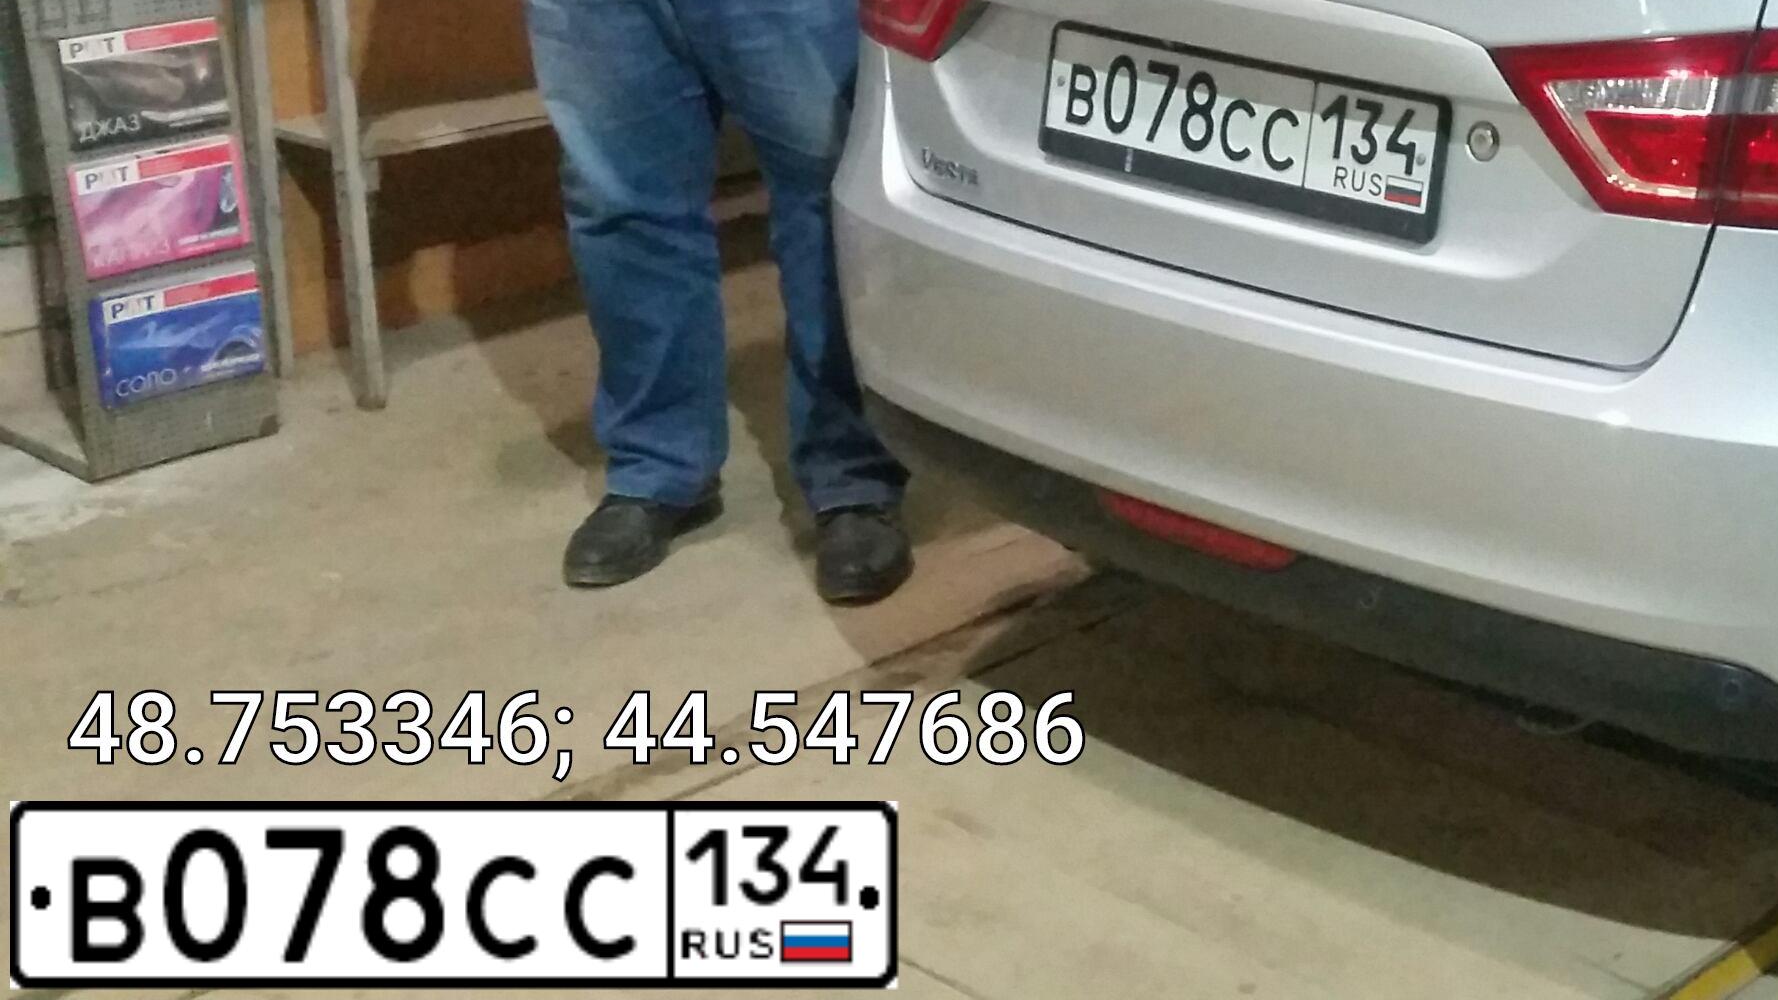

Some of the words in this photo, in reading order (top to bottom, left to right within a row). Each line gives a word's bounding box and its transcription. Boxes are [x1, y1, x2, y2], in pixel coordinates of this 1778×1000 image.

[1066, 54, 1301, 173] В078СС
[1319, 93, 1419, 177] 134
[1332, 165, 1384, 197] RUS
